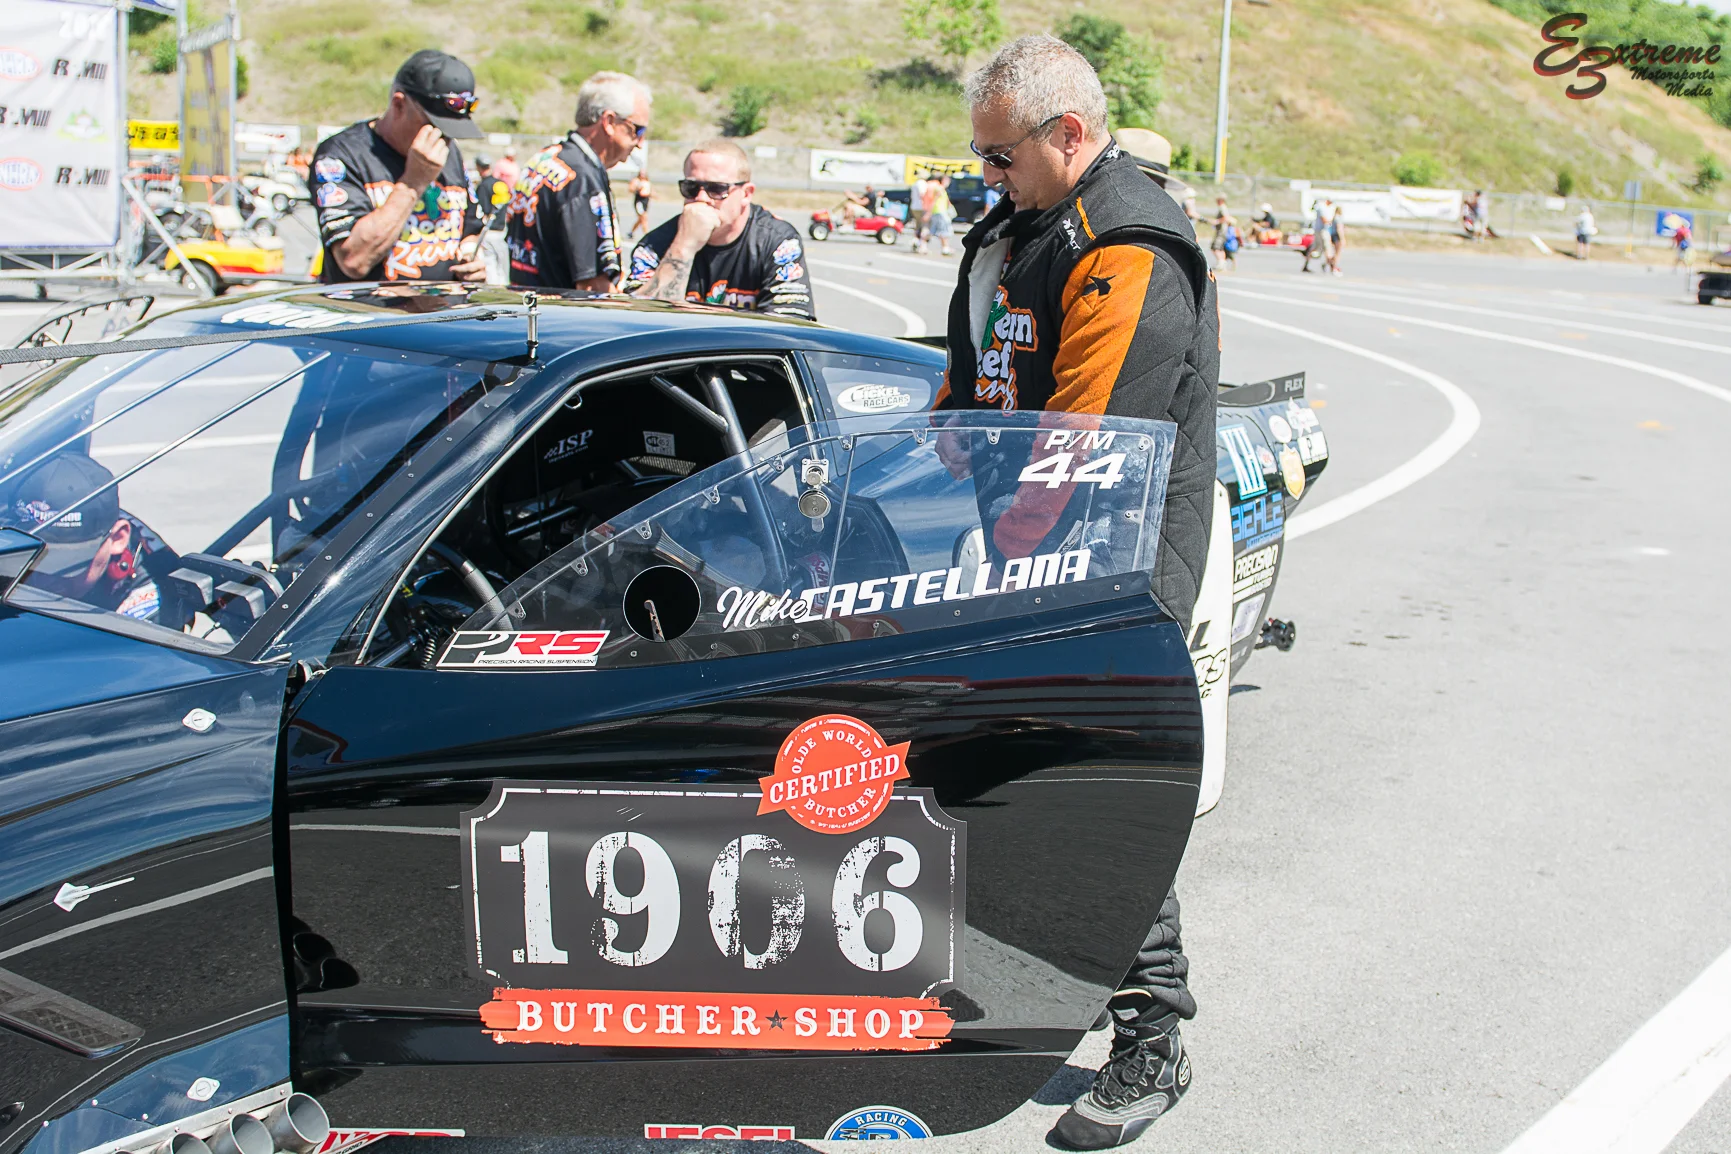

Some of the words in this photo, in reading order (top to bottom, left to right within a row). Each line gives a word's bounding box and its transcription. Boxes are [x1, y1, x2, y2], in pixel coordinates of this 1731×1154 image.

[1284, 378, 1304, 393] FLEX
[863, 398, 885, 408] RACE
[557, 429, 594, 455] ISP
[1044, 430, 1117, 450] P/M
[1017, 453, 1124, 489] 44
[717, 586, 808, 628] Mike
[794, 549, 1092, 623] CASTELLANA
[792, 738, 817, 774] OLDE
[822, 730, 872, 758] WORLD
[769, 753, 900, 804] CERTIFIED
[804, 787, 876, 819] BUTCHER
[501, 831, 923, 972] 1906
[516, 1001, 761, 1036] BUTCHER
[794, 1008, 924, 1040] SHOP
[855, 1112, 907, 1126] RACING
